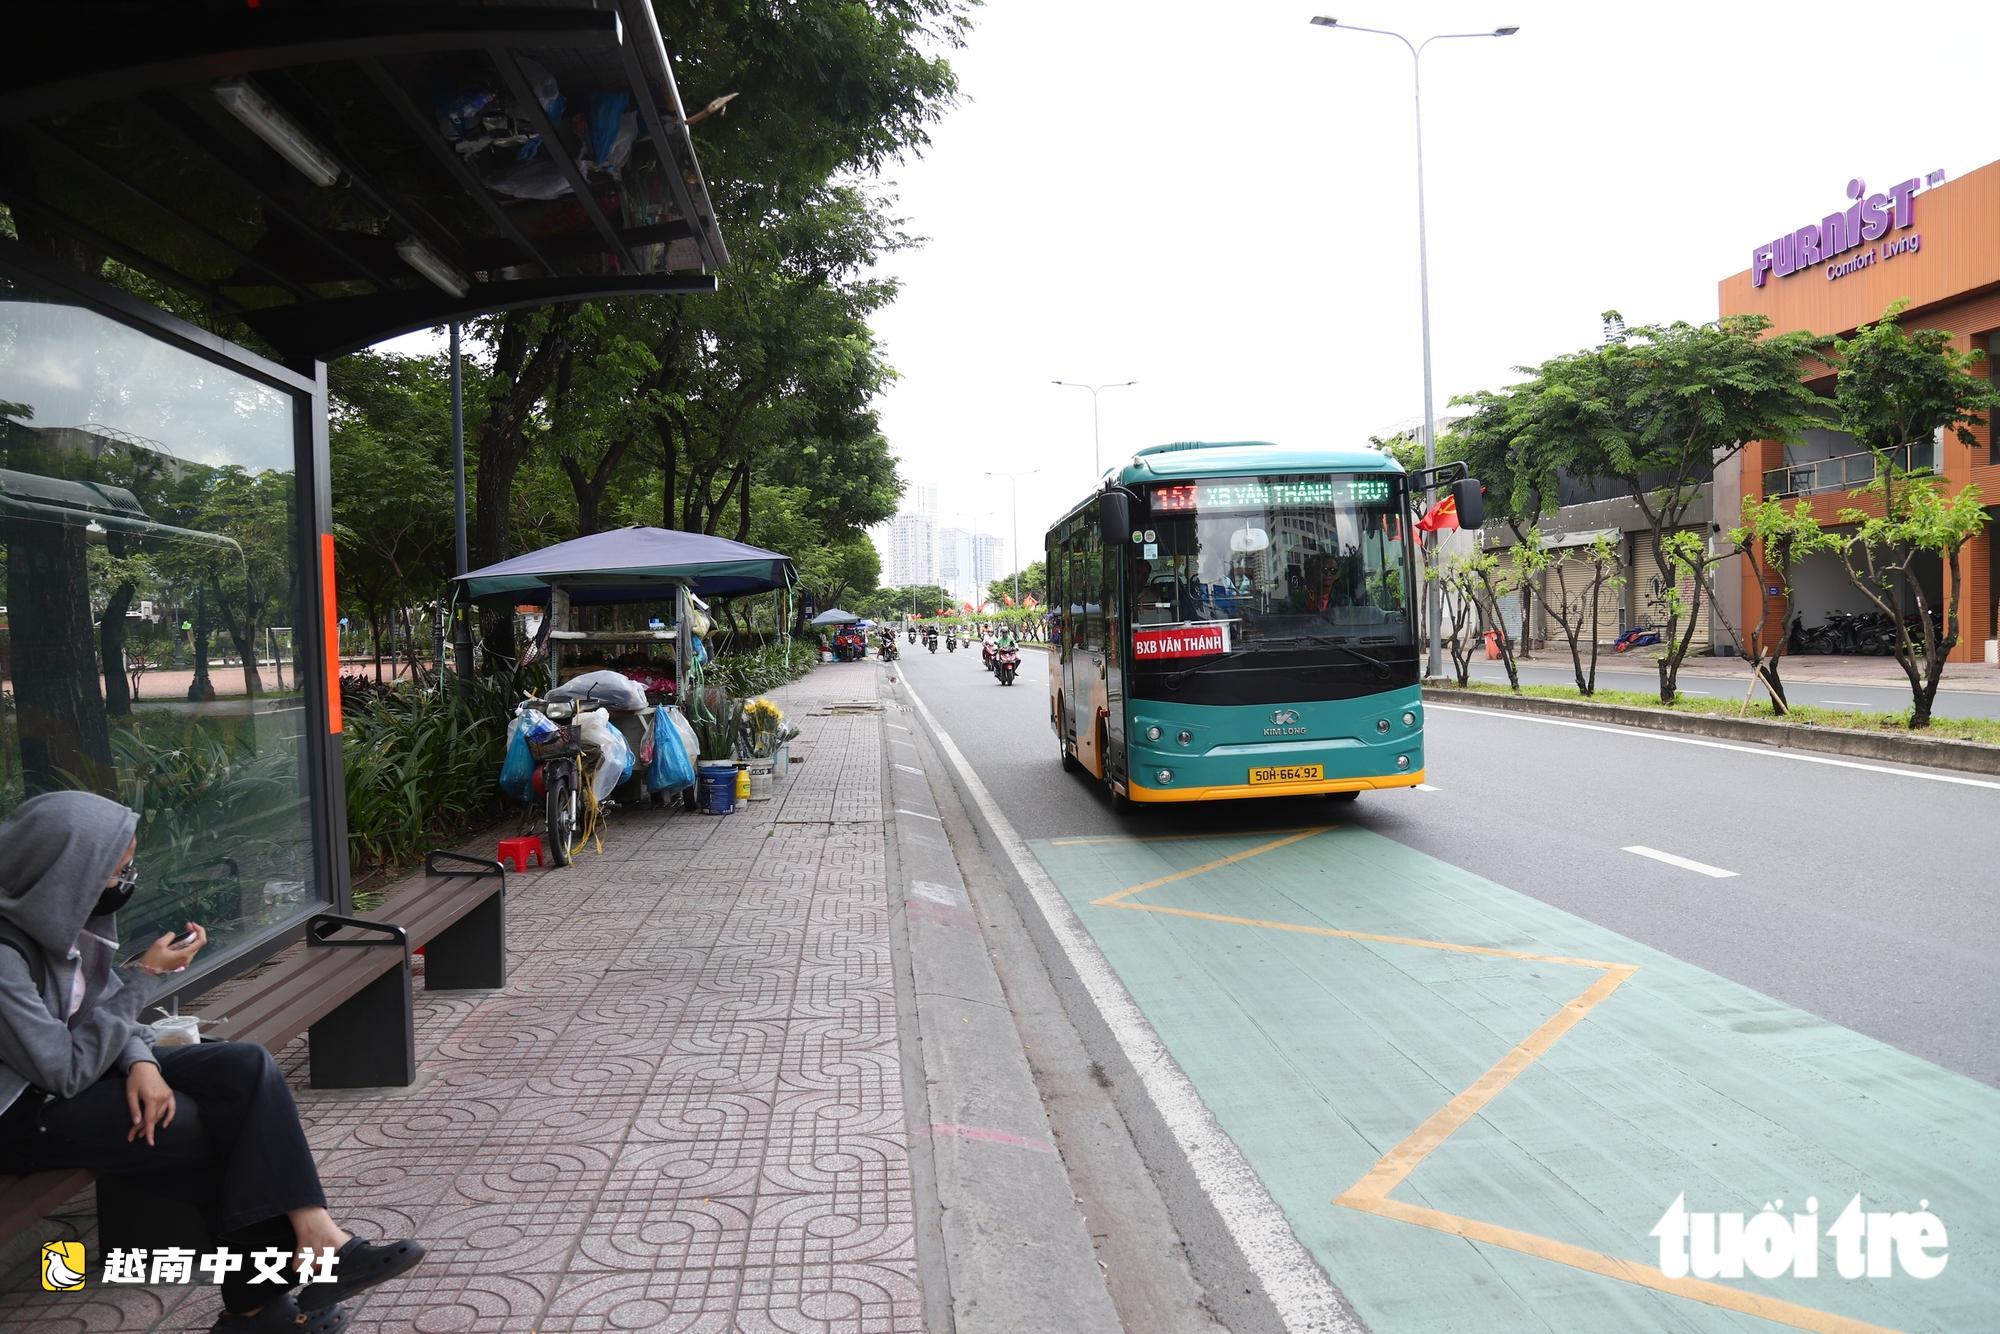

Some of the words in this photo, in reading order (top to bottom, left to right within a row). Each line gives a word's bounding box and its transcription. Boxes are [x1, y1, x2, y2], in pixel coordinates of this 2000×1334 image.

[1825, 249, 1876, 281] Comfort
[1881, 233, 1920, 261] Living
[1157, 485, 1198, 510] 157
[1136, 640, 1157, 655] BXB
[1159, 637, 1182, 653] VĂN
[1184, 634, 1222, 651] THÁNH
[1263, 728, 1281, 736] KIM
[1282, 727, 1307, 735] LONG
[1255, 767, 1318, 781] 50H-664.92
